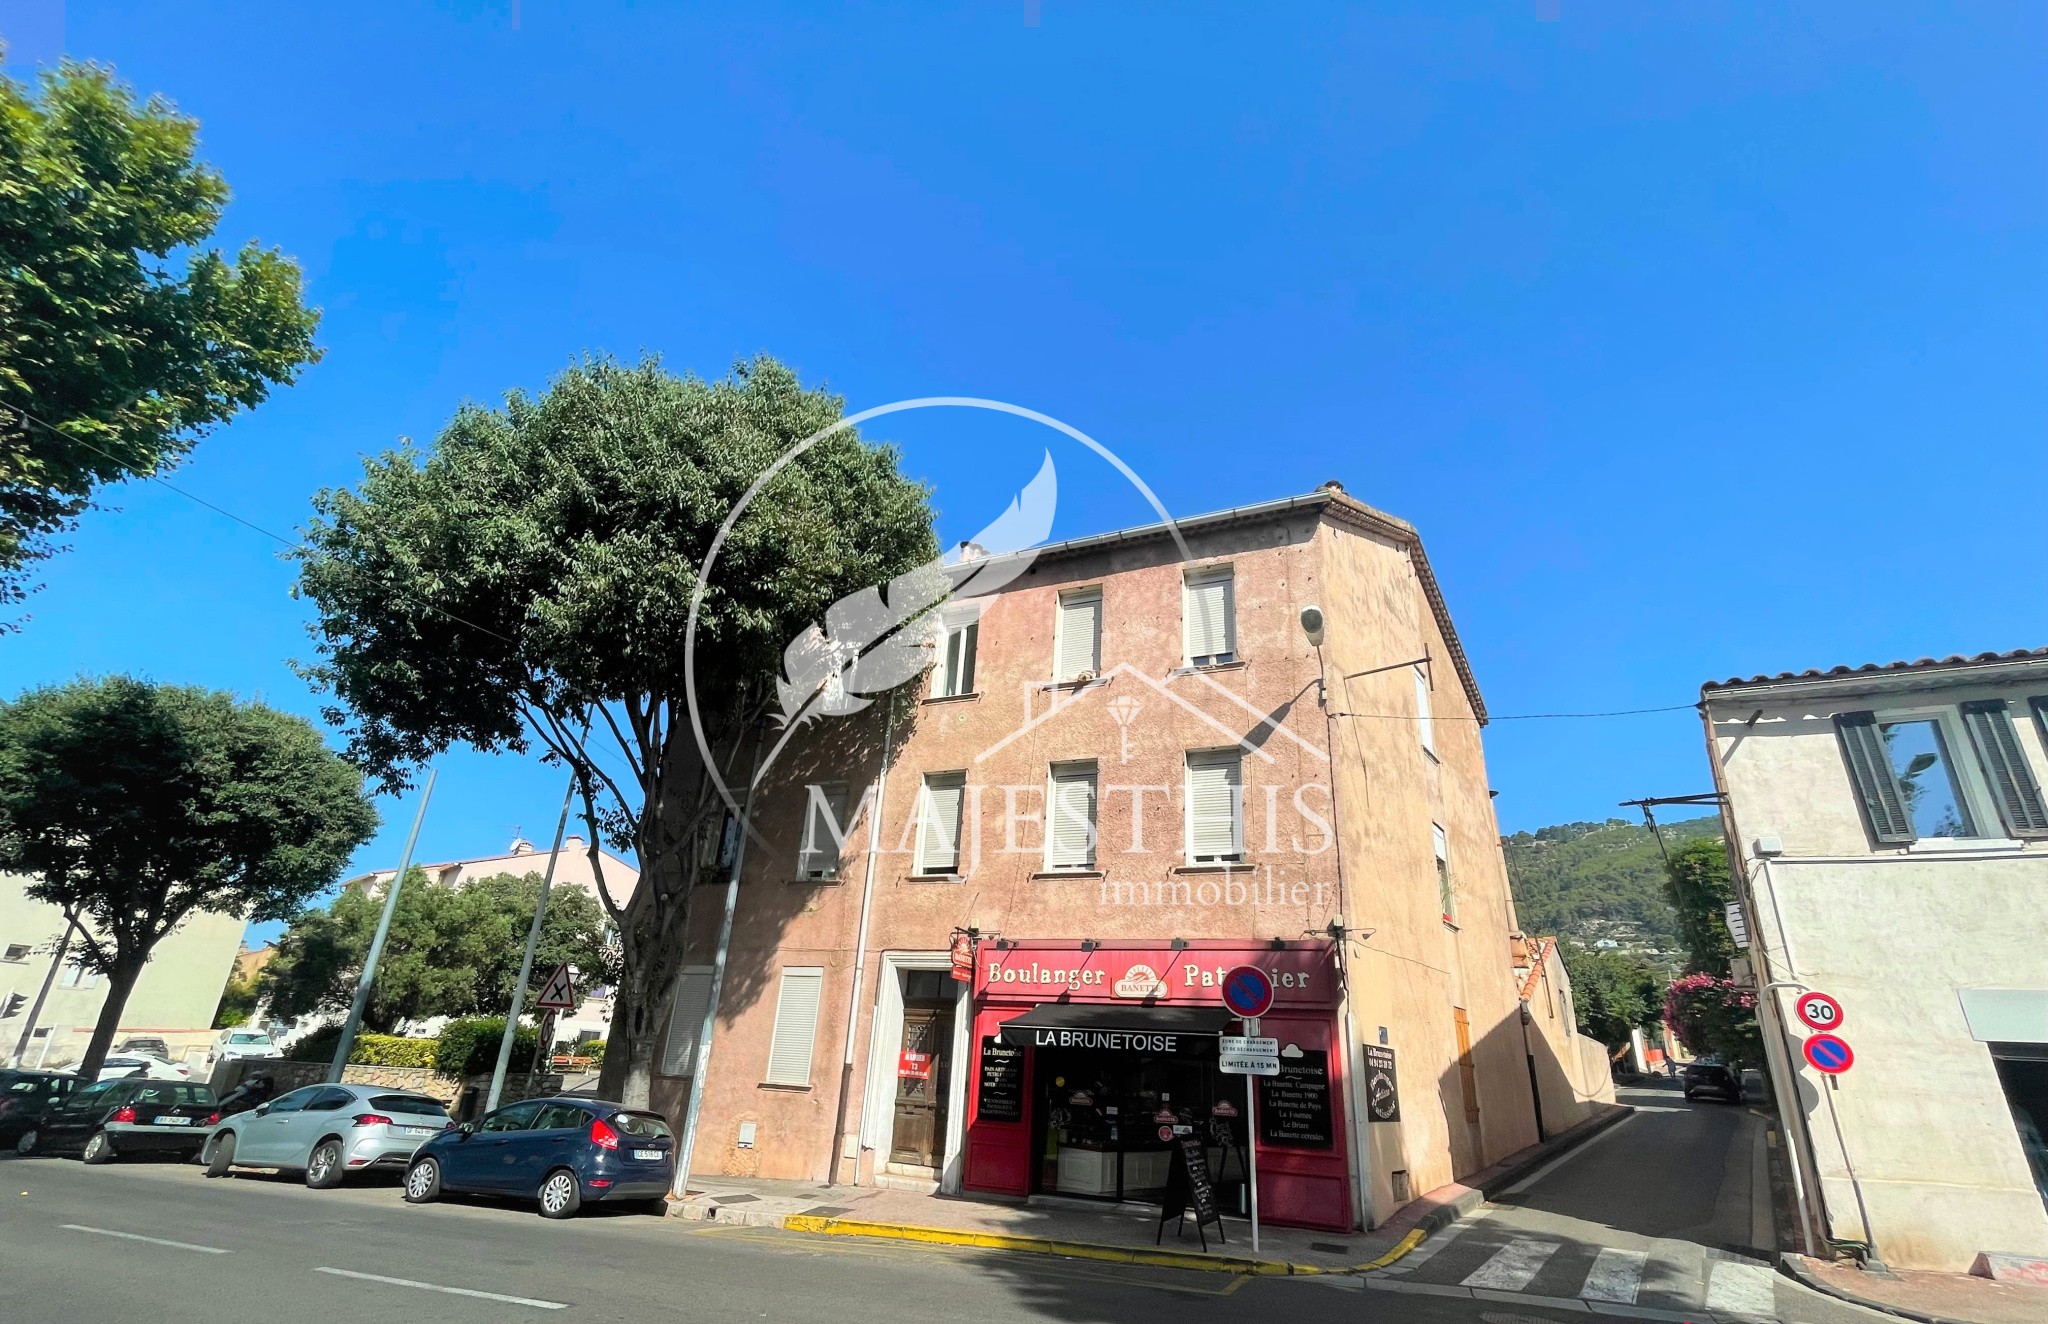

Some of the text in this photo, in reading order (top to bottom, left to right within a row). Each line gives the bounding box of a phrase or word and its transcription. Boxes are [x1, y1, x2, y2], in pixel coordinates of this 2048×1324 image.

[988, 962, 1106, 991] Boulanger
[1183, 964, 1311, 989] Patier
[1121, 984, 1161, 993] BANETTE
[1807, 1003, 1835, 1021] 30
[1035, 1030, 1177, 1052] LA BRUNETOISE
[983, 1047, 991, 1056] La
[1221, 1060, 1249, 1068] LIMITÉE
